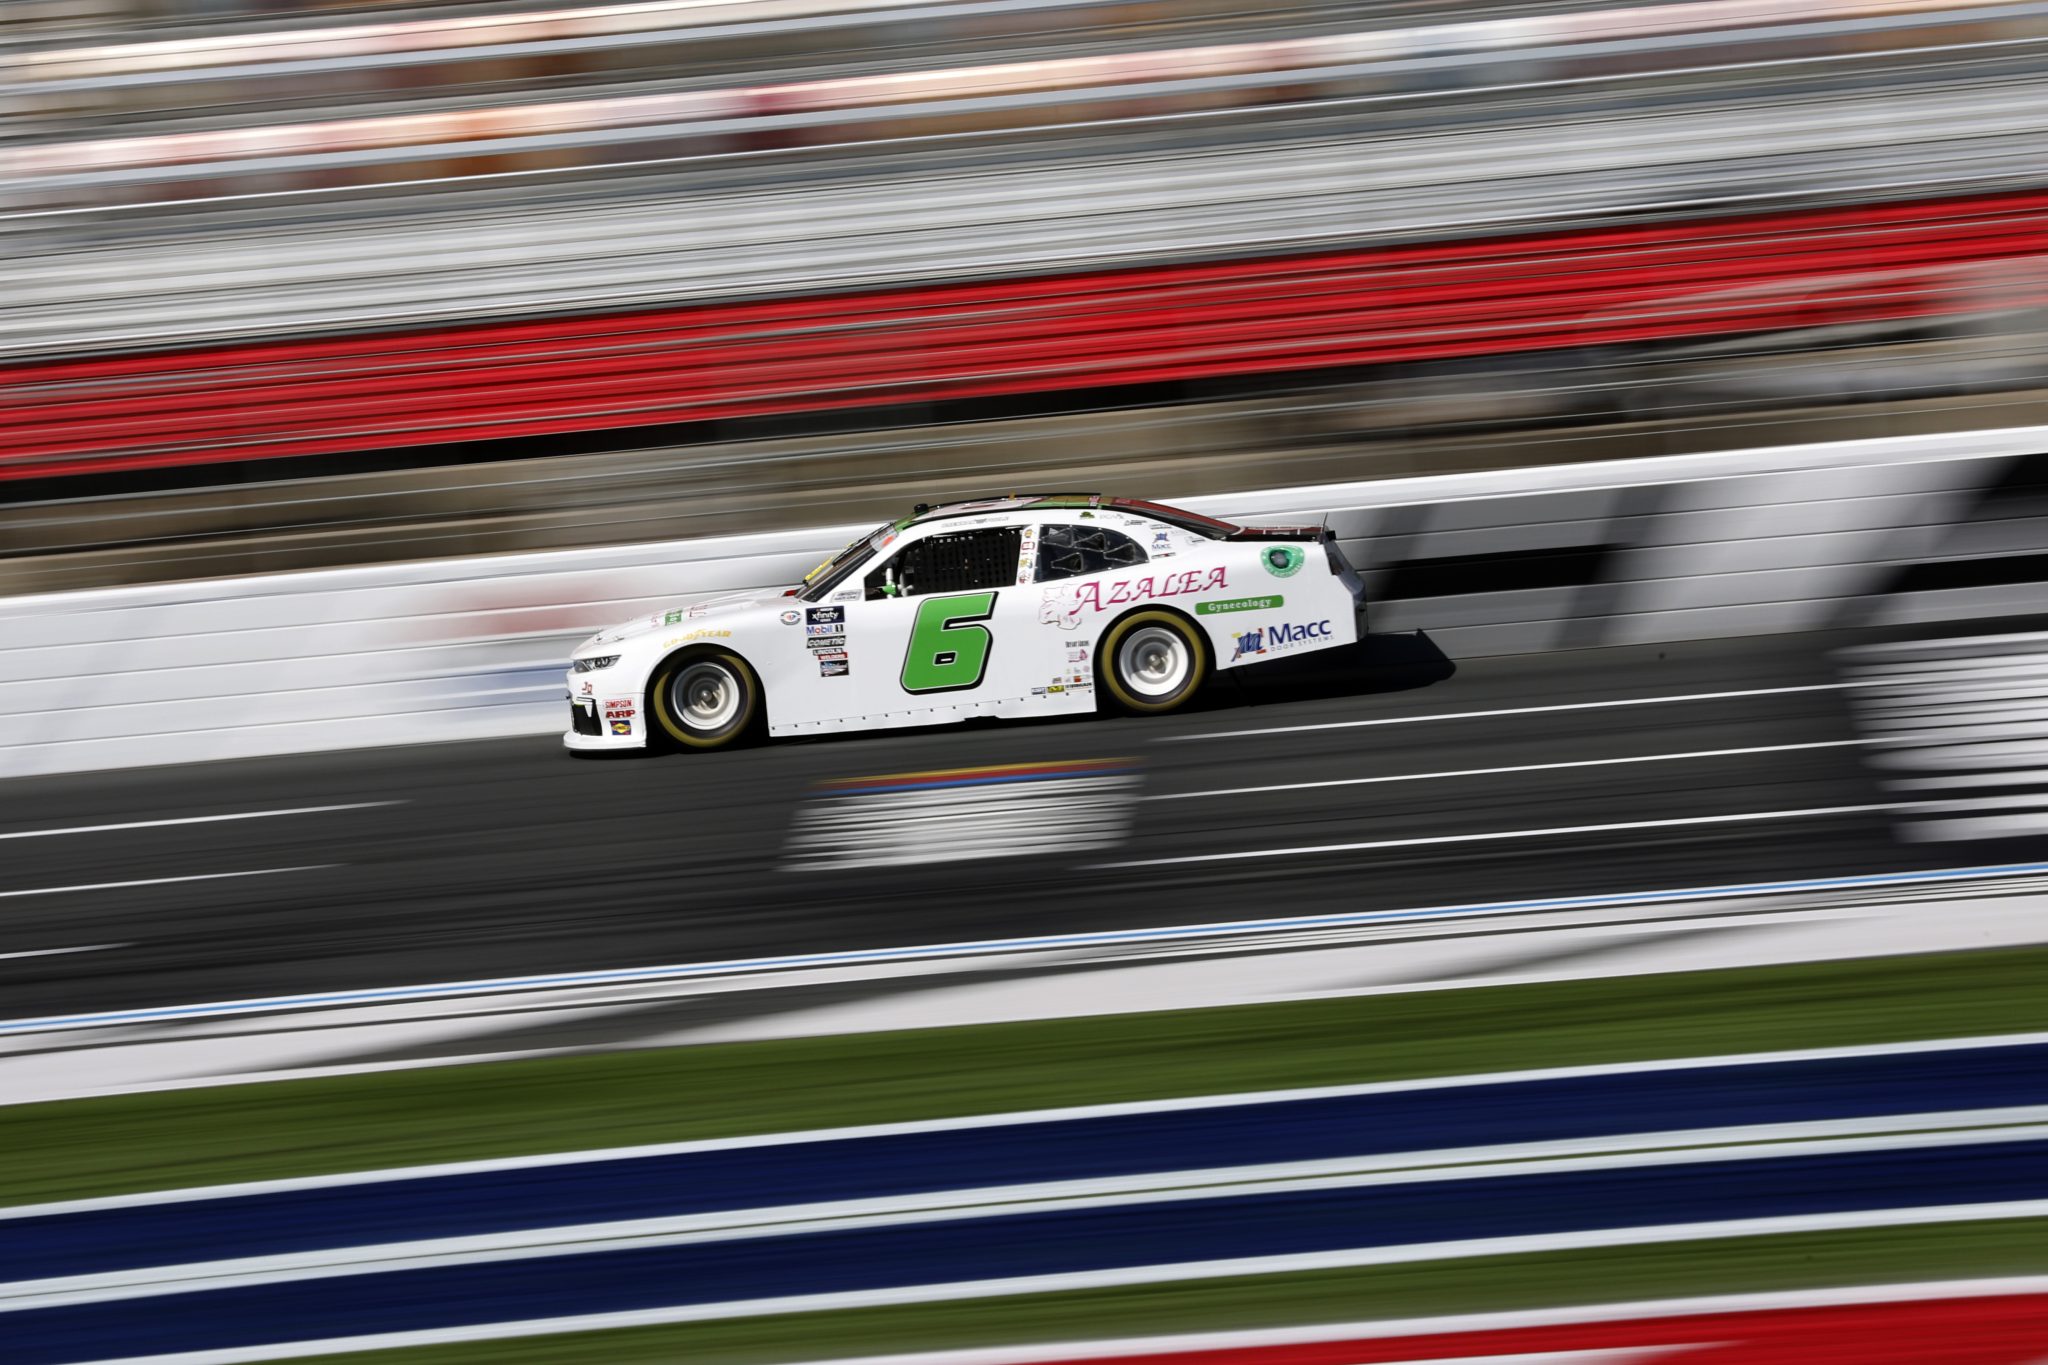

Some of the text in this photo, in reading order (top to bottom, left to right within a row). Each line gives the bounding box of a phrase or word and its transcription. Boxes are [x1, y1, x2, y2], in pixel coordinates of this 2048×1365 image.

[1068, 566, 1229, 616] AZALEA
[1208, 598, 1272, 613] Gynecology
[811, 611, 839, 621] xfinity
[806, 625, 832, 635] Mobil
[1268, 620, 1331, 646] Macc
[900, 591, 999, 695] 6
[605, 700, 632, 708] SIMPSON
[606, 710, 636, 719] ARP
